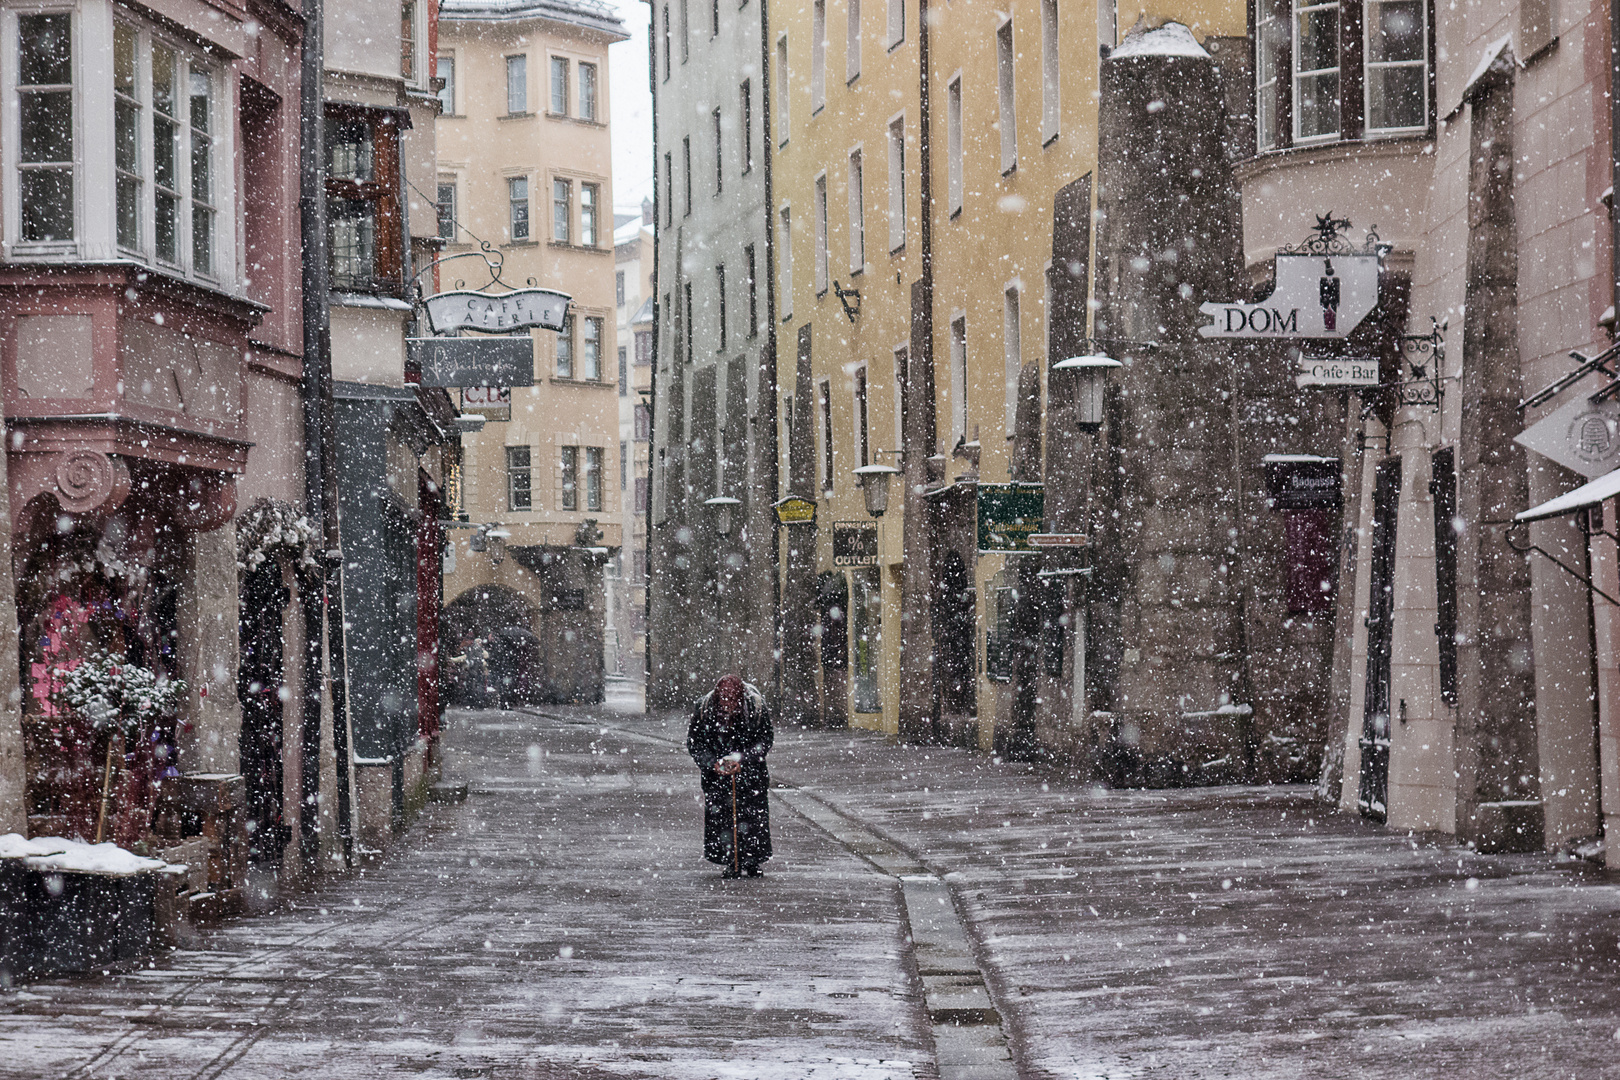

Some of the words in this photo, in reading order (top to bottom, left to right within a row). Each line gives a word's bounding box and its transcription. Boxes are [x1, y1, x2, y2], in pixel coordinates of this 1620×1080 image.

[1224, 308, 1300, 332] DOM
[1312, 365, 1343, 379] Cafe
[1352, 366, 1376, 379] Bar
